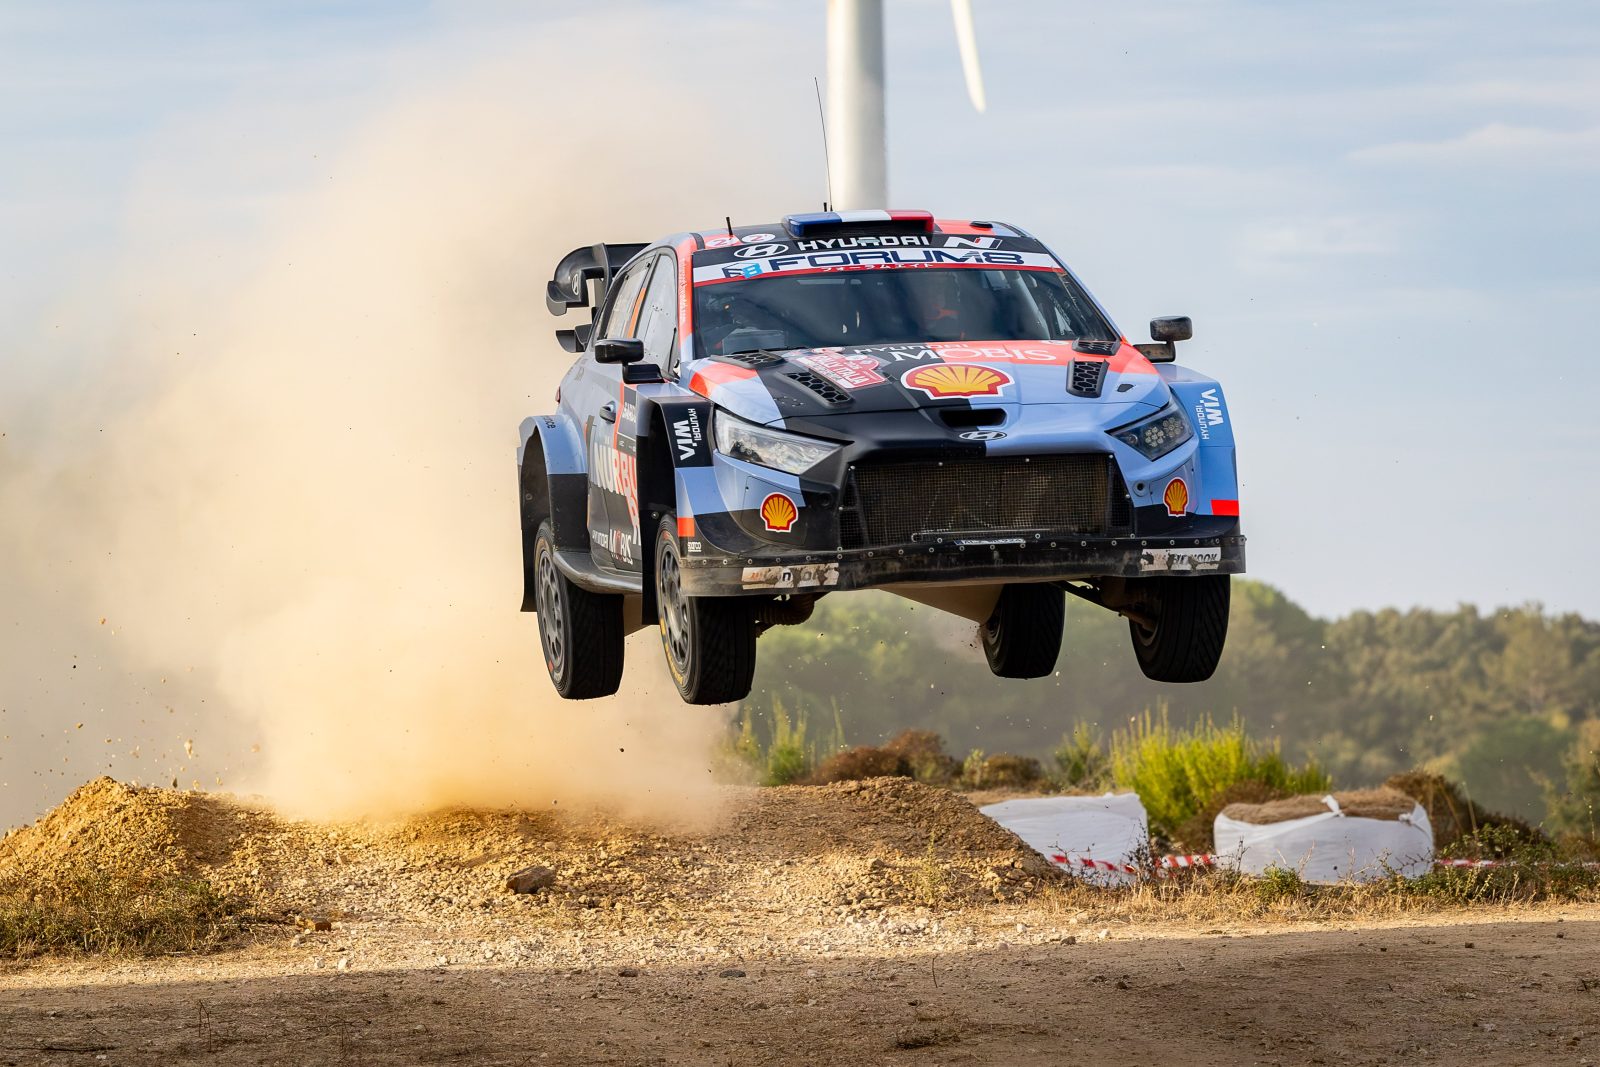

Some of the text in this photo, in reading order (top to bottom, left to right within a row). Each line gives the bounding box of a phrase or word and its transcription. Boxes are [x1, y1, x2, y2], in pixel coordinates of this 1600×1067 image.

[797, 235, 930, 251] HYUNDAI
[768, 250, 1025, 271] FORUM8
[854, 343, 969, 354] HYUNDAI
[888, 349, 1057, 361] MOBIS
[1200, 388, 1224, 426] WIA
[687, 408, 702, 441] HYUNDAI
[1195, 405, 1210, 440] HYUNDAI
[672, 419, 698, 461] WIA
